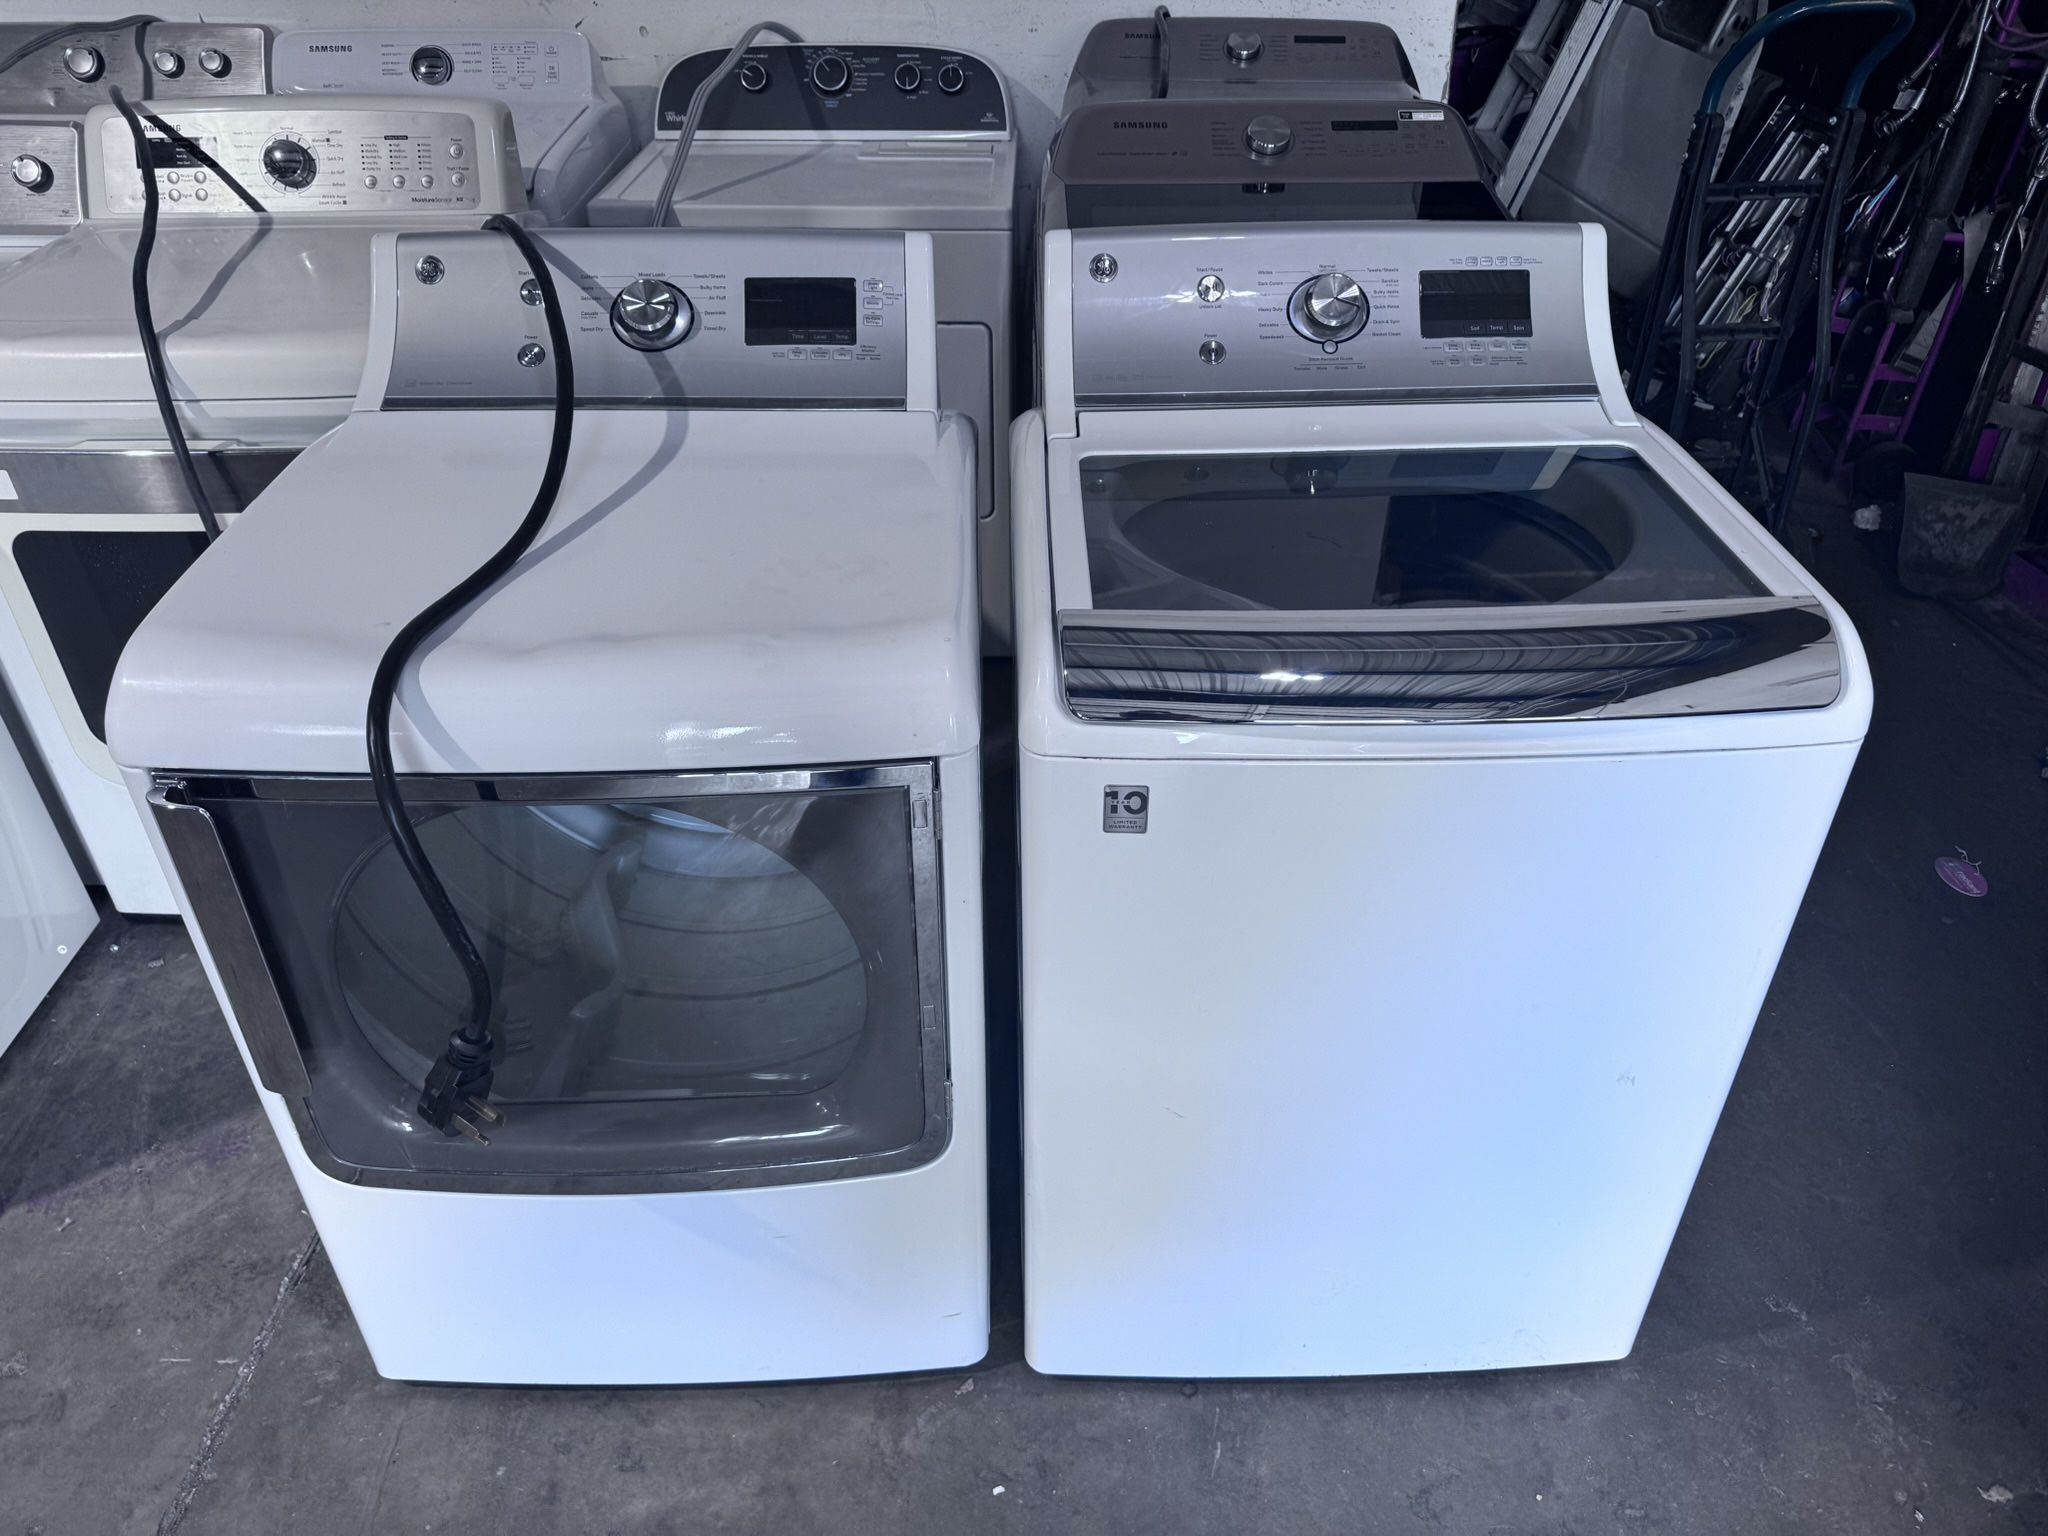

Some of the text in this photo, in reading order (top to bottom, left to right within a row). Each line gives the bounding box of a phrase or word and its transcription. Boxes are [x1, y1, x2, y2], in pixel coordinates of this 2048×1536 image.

[309, 45, 353, 53] SAMSUNG
[143, 124, 181, 132] AMSUNG
[1113, 121, 1168, 129] SAMSUNG
[1105, 791, 1147, 815] 10
